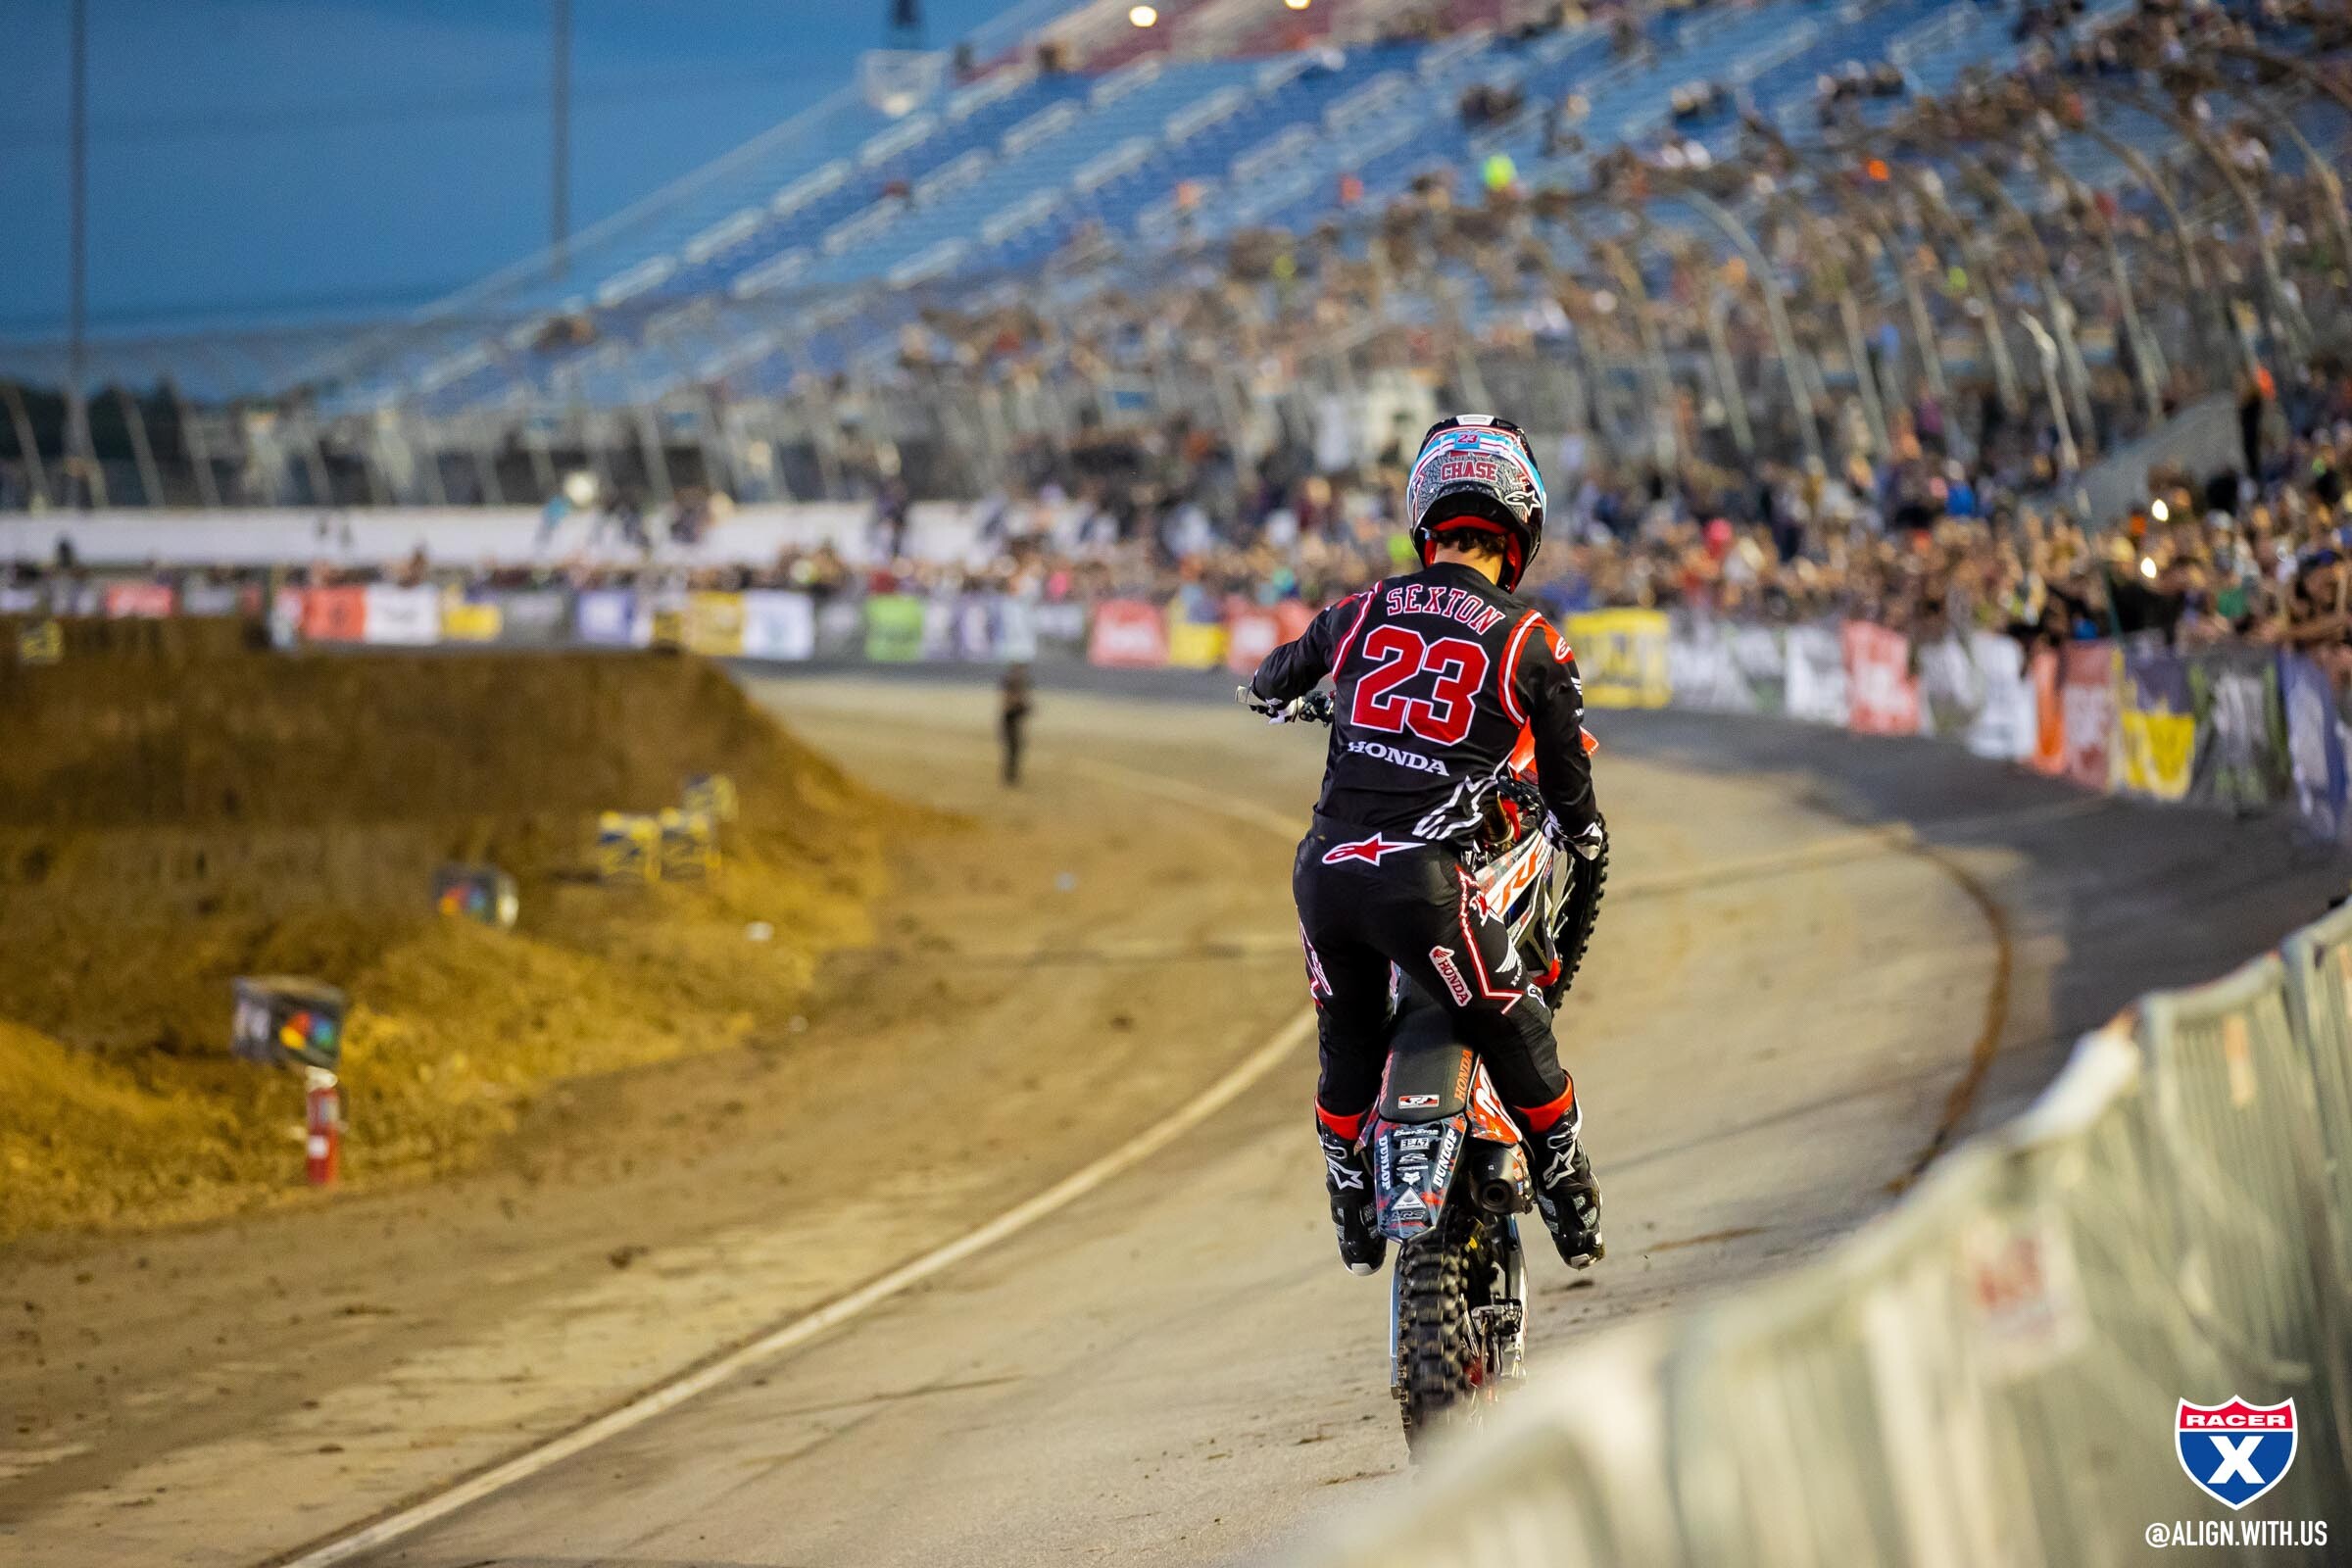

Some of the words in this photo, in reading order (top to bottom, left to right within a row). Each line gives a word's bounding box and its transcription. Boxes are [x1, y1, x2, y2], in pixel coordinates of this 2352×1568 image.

[1457, 434, 1477, 443] 23
[1441, 461, 1497, 482] CHASE
[1387, 584, 1505, 635] SEXTON
[1350, 624, 1490, 746] 23
[1348, 741, 1449, 776] HONDA
[1438, 958, 1469, 1004] HONDA
[1454, 1049, 1473, 1102] HONDA
[1379, 1135, 1391, 1191] DUNLOP
[1433, 1128, 1457, 1188] DUNLOP
